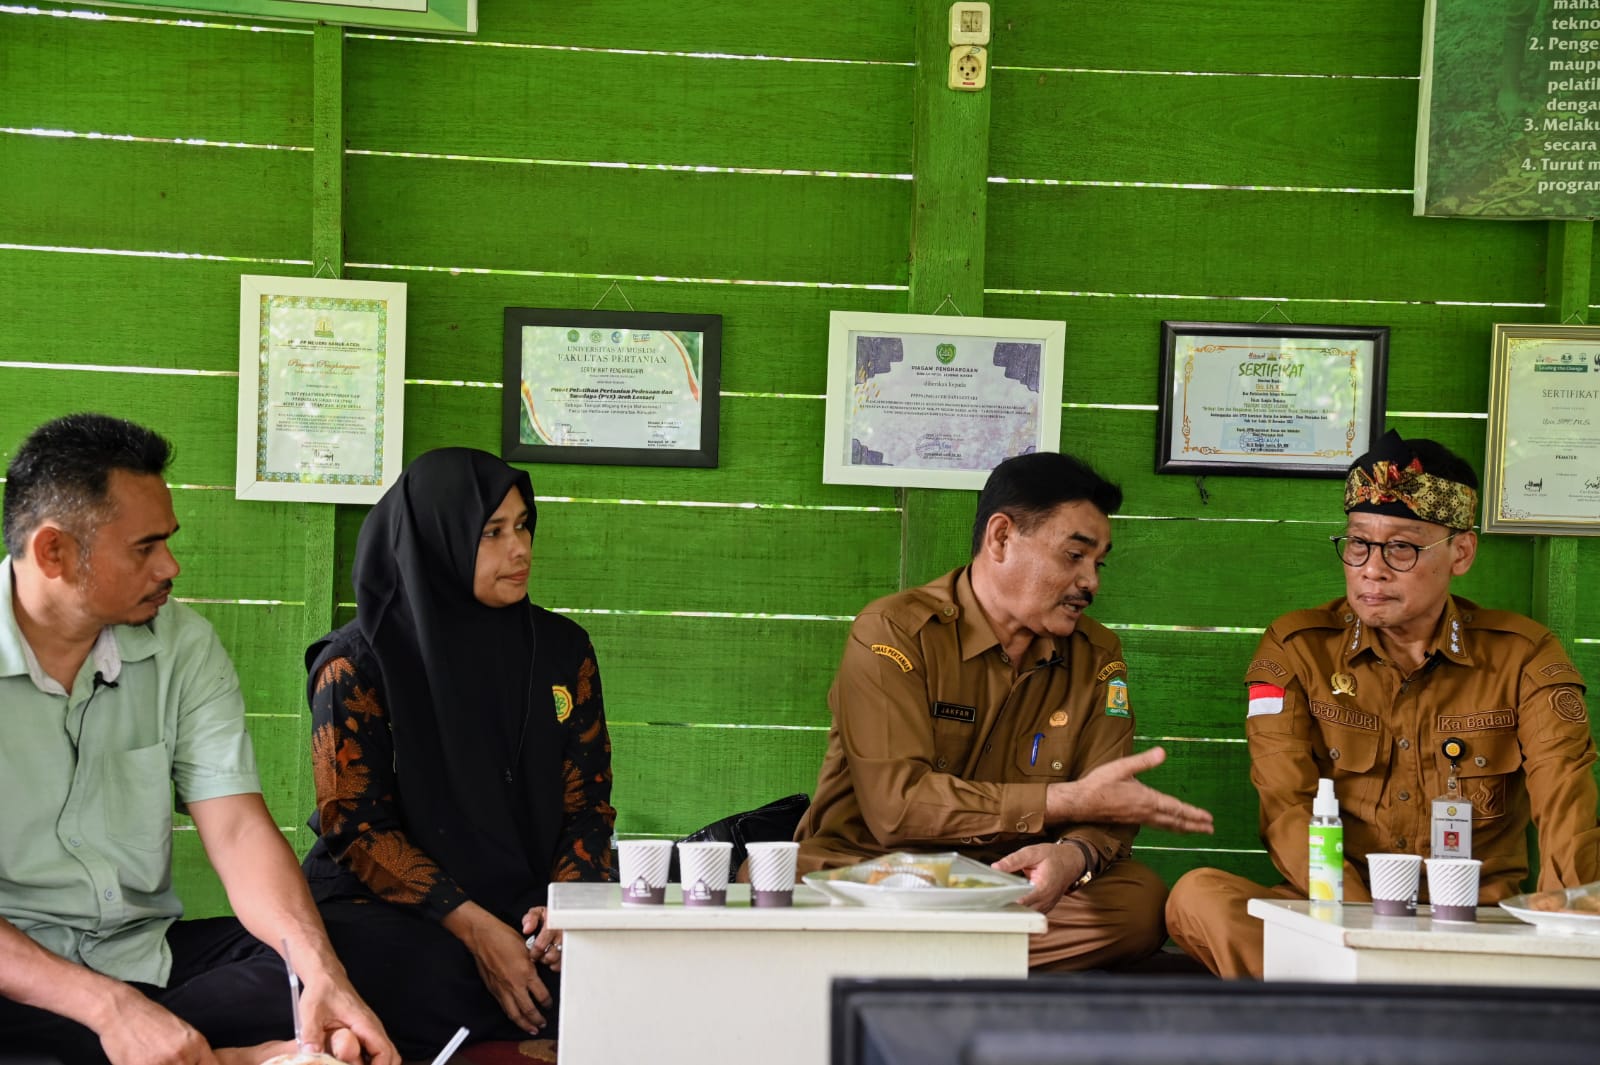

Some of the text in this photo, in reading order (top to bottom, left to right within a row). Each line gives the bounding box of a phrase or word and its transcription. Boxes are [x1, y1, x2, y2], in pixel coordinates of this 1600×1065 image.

[1552, 16, 1600, 30] tekno
[1529, 37, 1599, 53] 2. Penge
[1546, 98, 1600, 114] denga
[1524, 118, 1600, 131] 3. Melaku
[1544, 141, 1597, 151] secara
[1521, 158, 1536, 171] 4.
[1540, 158, 1584, 171] Turut
[558, 353, 667, 364] FAKULTAS PERTANIAN
[1238, 363, 1304, 378] SERTIFIKAT
[1542, 389, 1599, 399] SERTIFIKAT
[1345, 711, 1373, 728] NUR
[1441, 713, 1511, 731] Ka Badan
